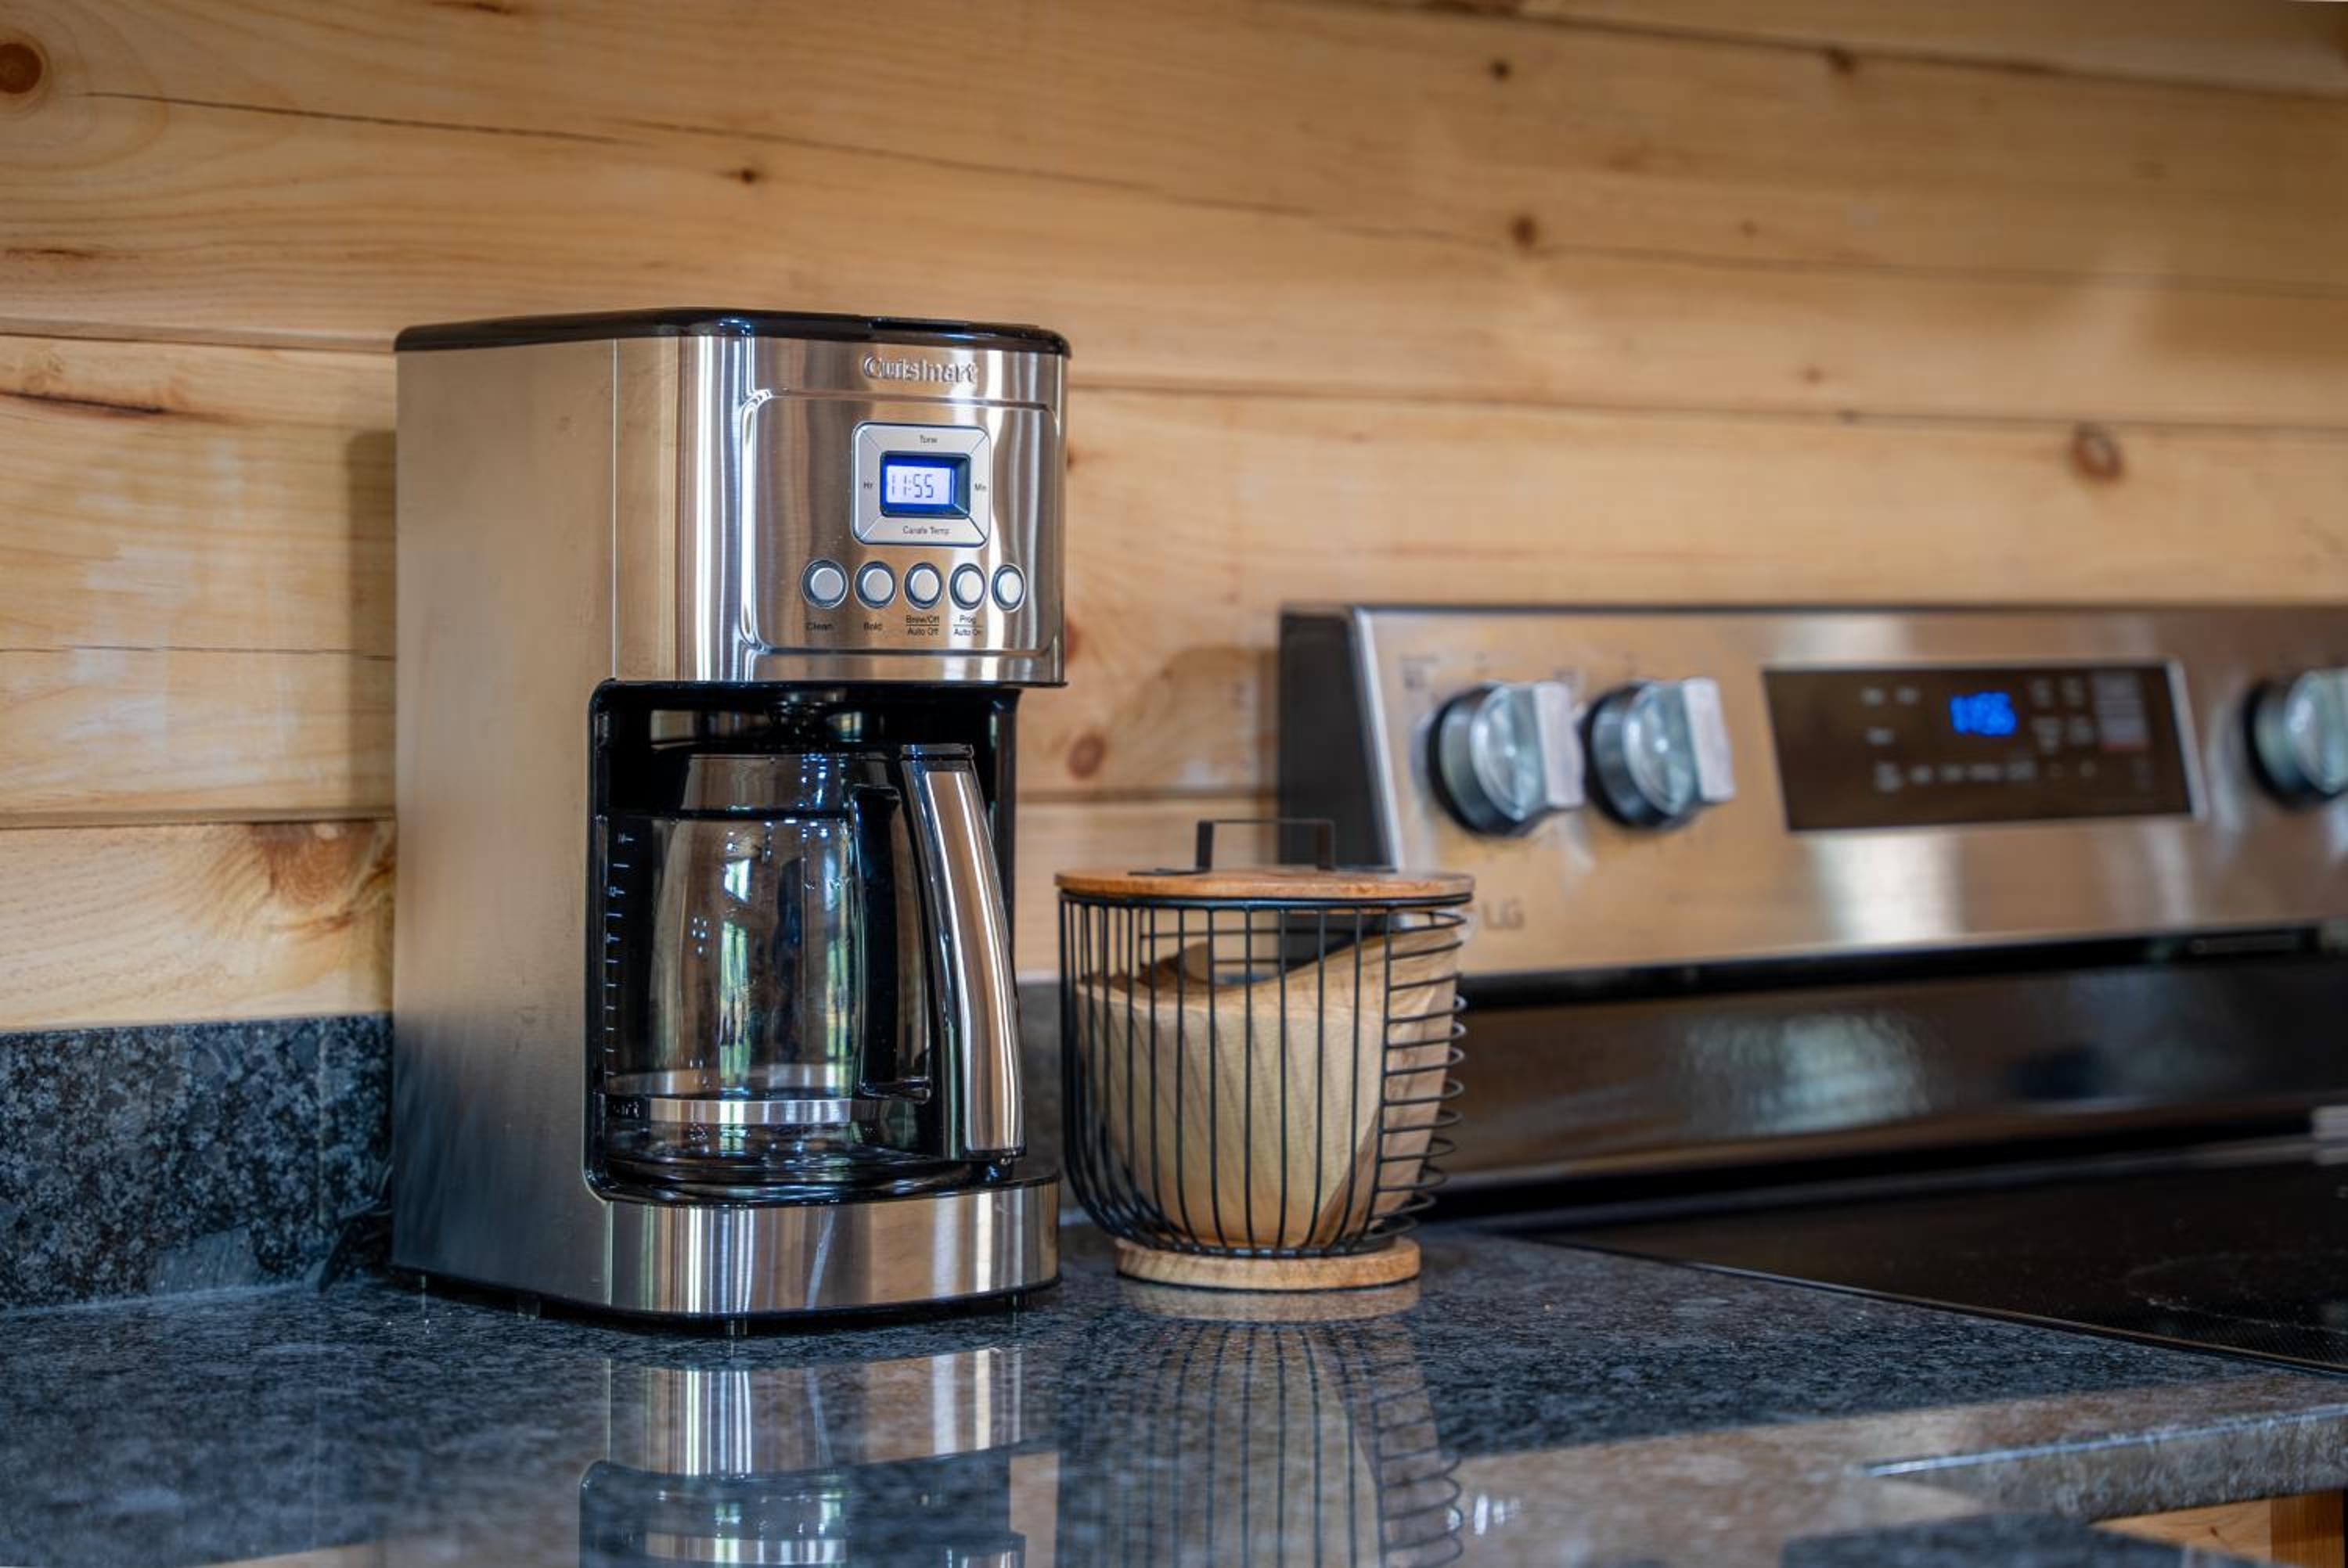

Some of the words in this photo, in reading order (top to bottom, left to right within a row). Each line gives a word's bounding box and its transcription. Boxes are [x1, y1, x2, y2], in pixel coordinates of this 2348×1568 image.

[863, 356, 978, 383] Cuisinart
[891, 473, 934, 498] 11:55
[907, 628, 926, 636] Auto
[953, 628, 971, 636] Auto
[1482, 897, 1525, 931] LG
